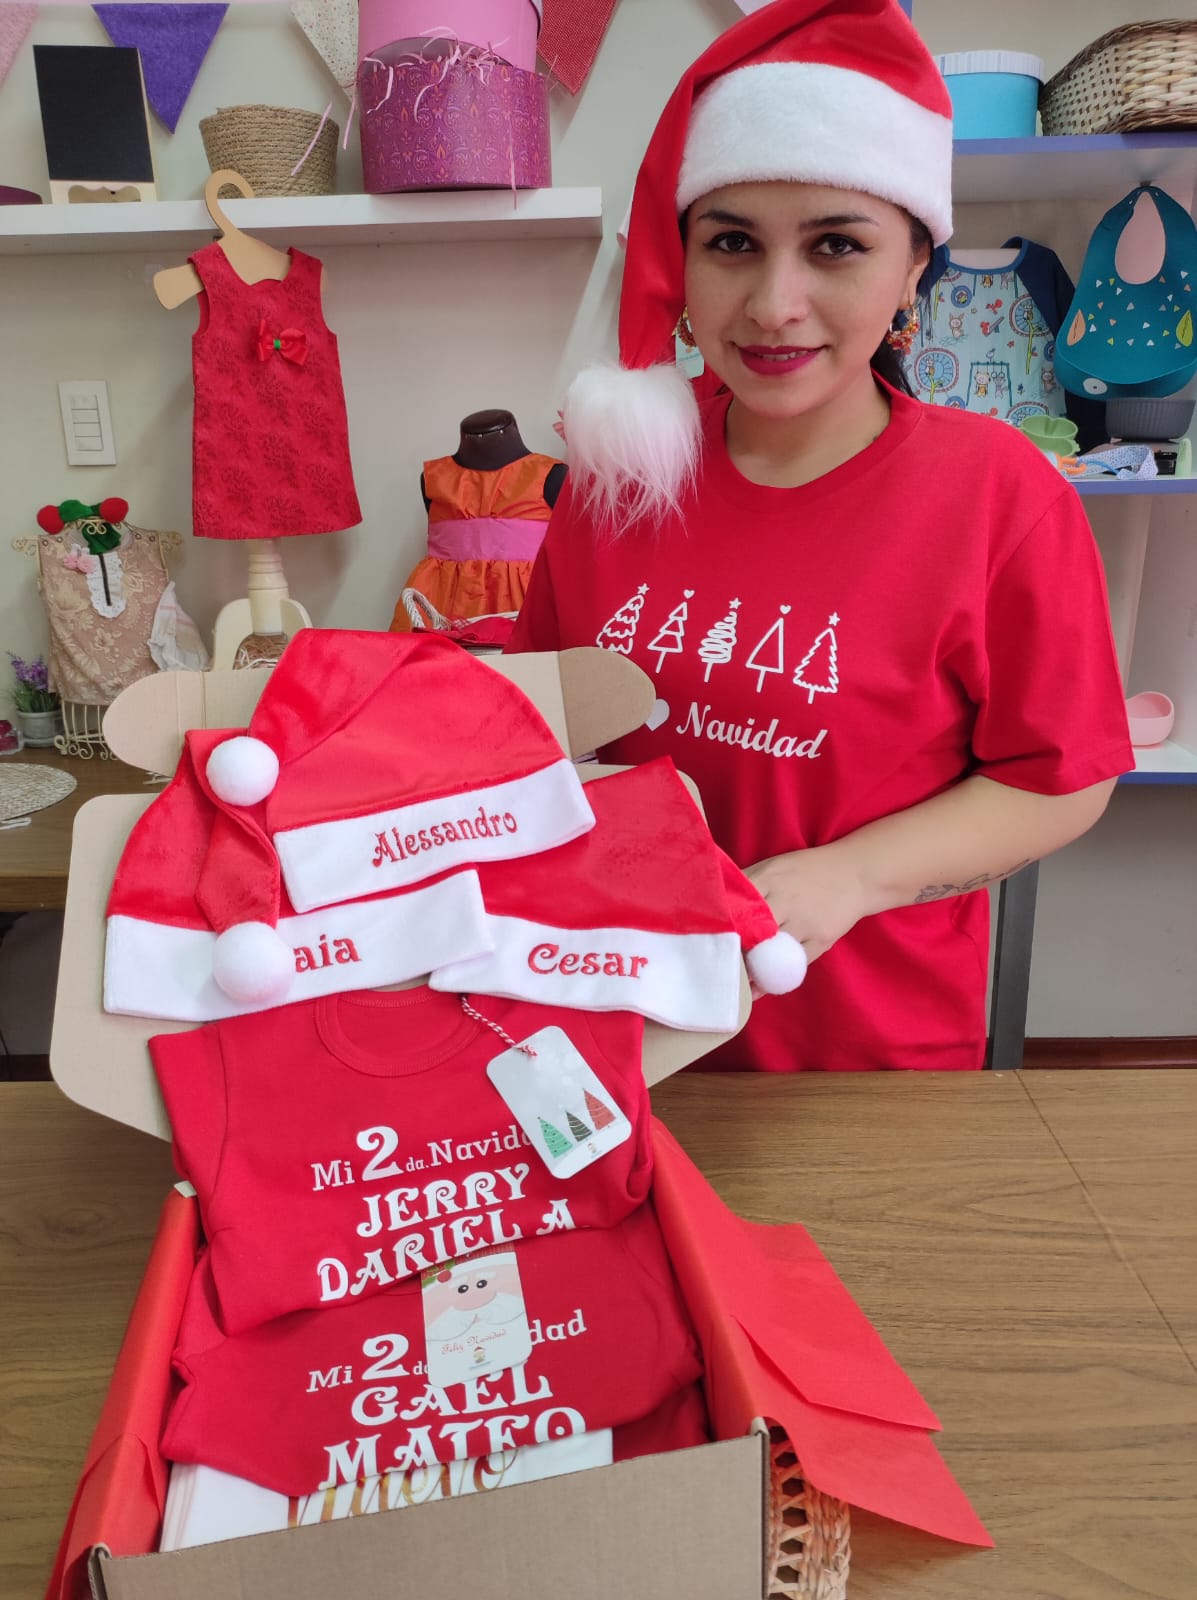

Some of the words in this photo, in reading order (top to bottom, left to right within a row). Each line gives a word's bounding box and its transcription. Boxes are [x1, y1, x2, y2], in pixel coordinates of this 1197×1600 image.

[676, 702, 828, 759] Navidad
[372, 806, 518, 867] Alessandro
[293, 934, 362, 973] aia
[528, 943, 649, 978] Cesar
[311, 1160, 355, 1191] Mi
[357, 1163, 529, 1237] JERRY
[317, 1209, 523, 1301] DARIEL
[306, 1366, 353, 1393] Mi
[529, 1309, 587, 1346] dad
[352, 1361, 554, 1426] GAEL
